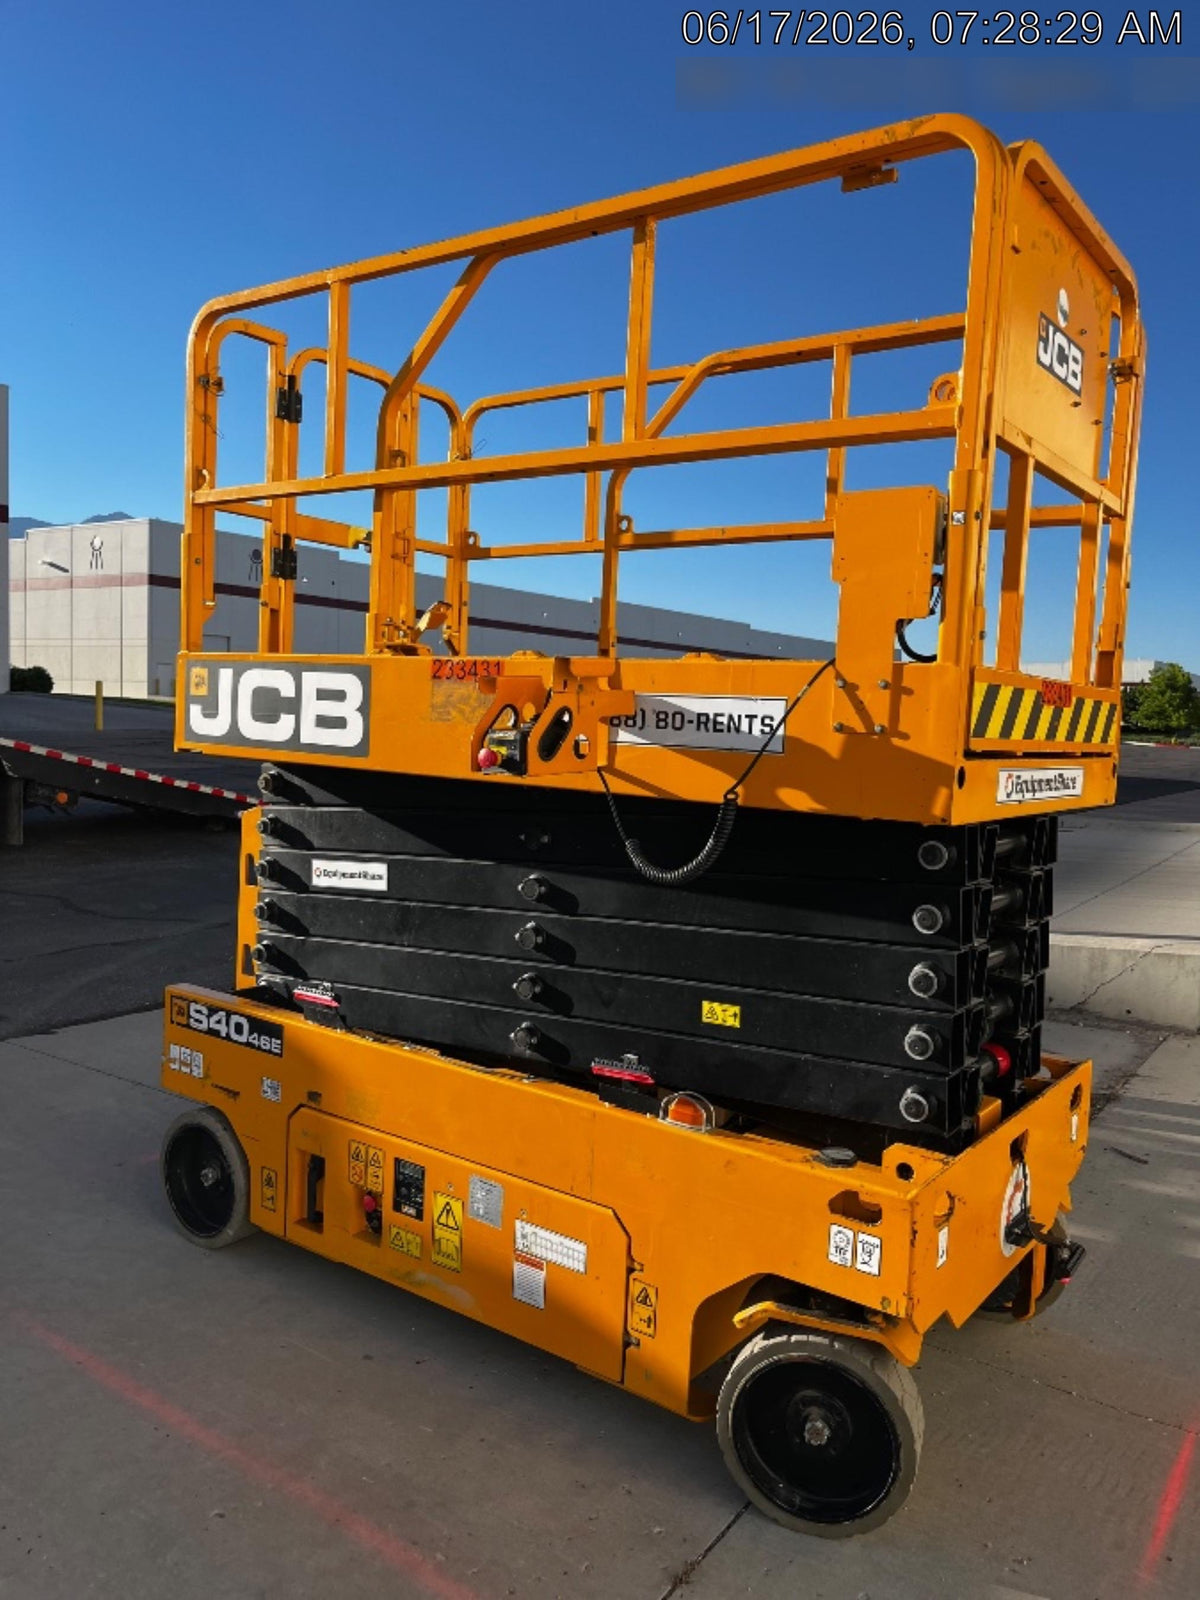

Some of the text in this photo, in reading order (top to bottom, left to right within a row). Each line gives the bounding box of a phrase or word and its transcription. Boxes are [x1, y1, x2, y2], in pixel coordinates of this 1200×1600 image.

[1038, 324, 1083, 393] JCB
[432, 658, 501, 680] 233431
[189, 667, 364, 748] JCB
[655, 710, 775, 735] 80-RENTS
